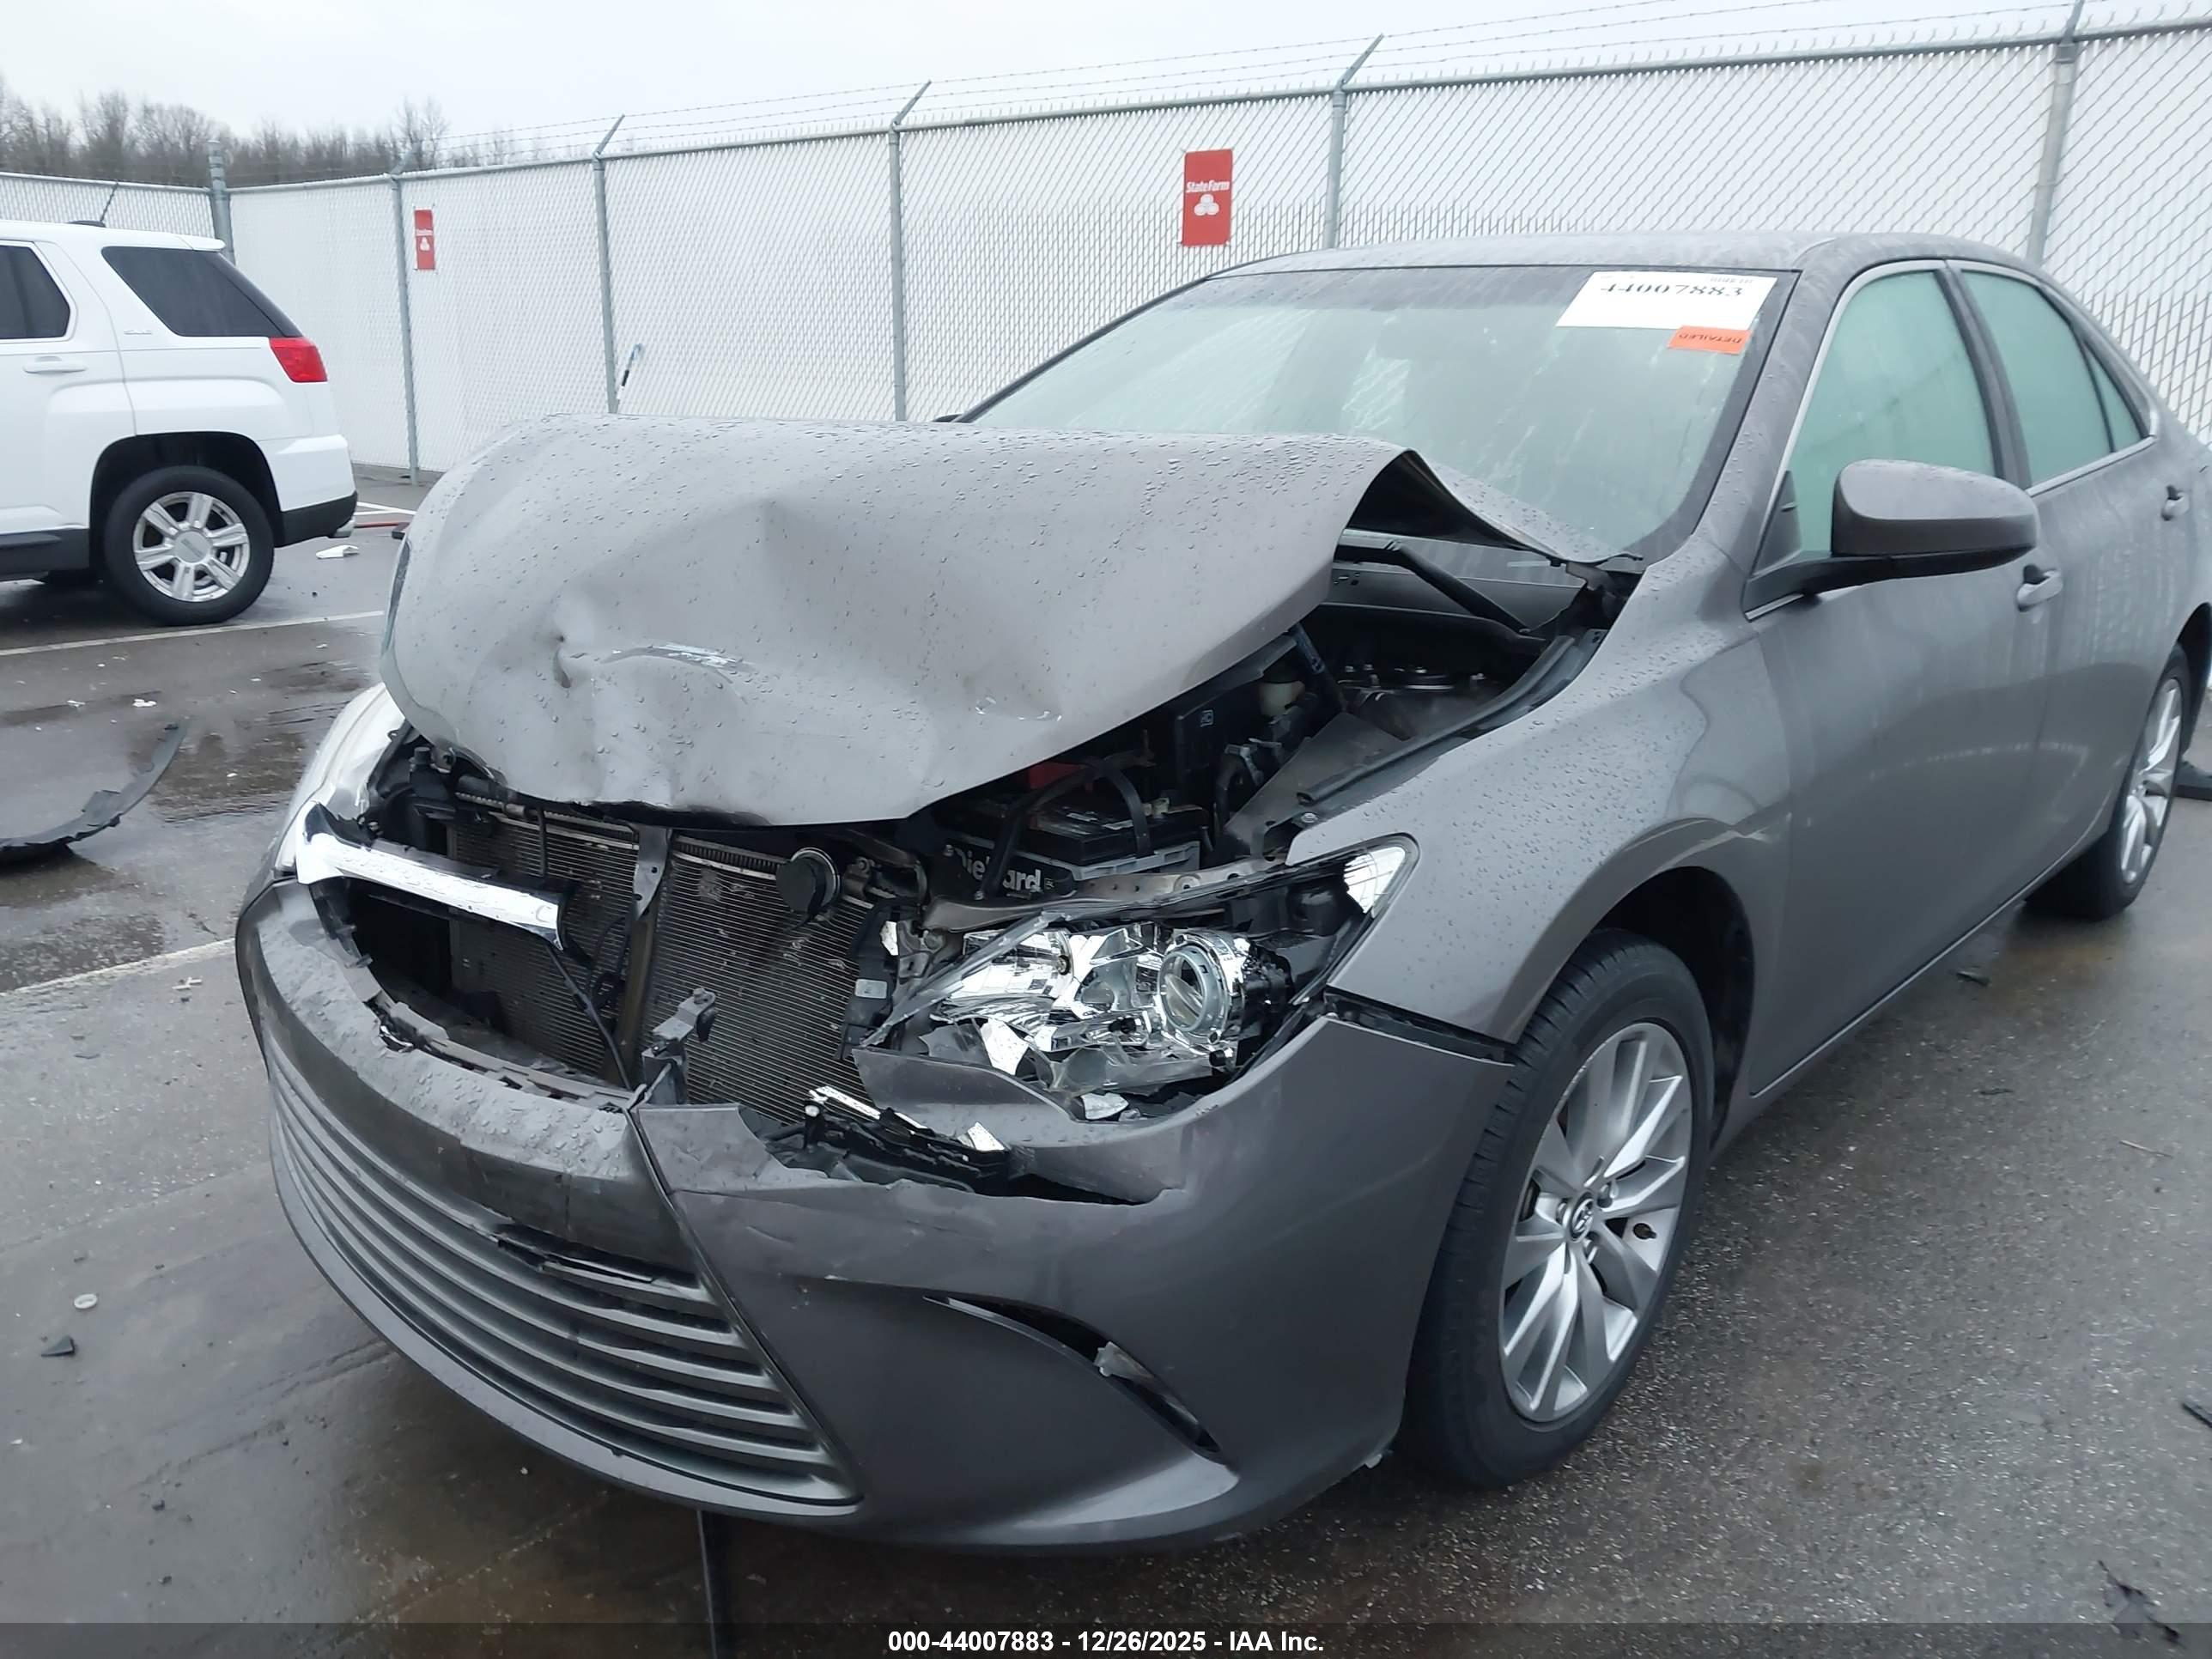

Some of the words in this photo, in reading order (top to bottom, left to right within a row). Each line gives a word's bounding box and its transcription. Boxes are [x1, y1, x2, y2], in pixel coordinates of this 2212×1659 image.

[1600, 283, 1744, 297] 44007883
[1678, 332, 1743, 344] DETAILED
[951, 846, 1043, 893] ieard
